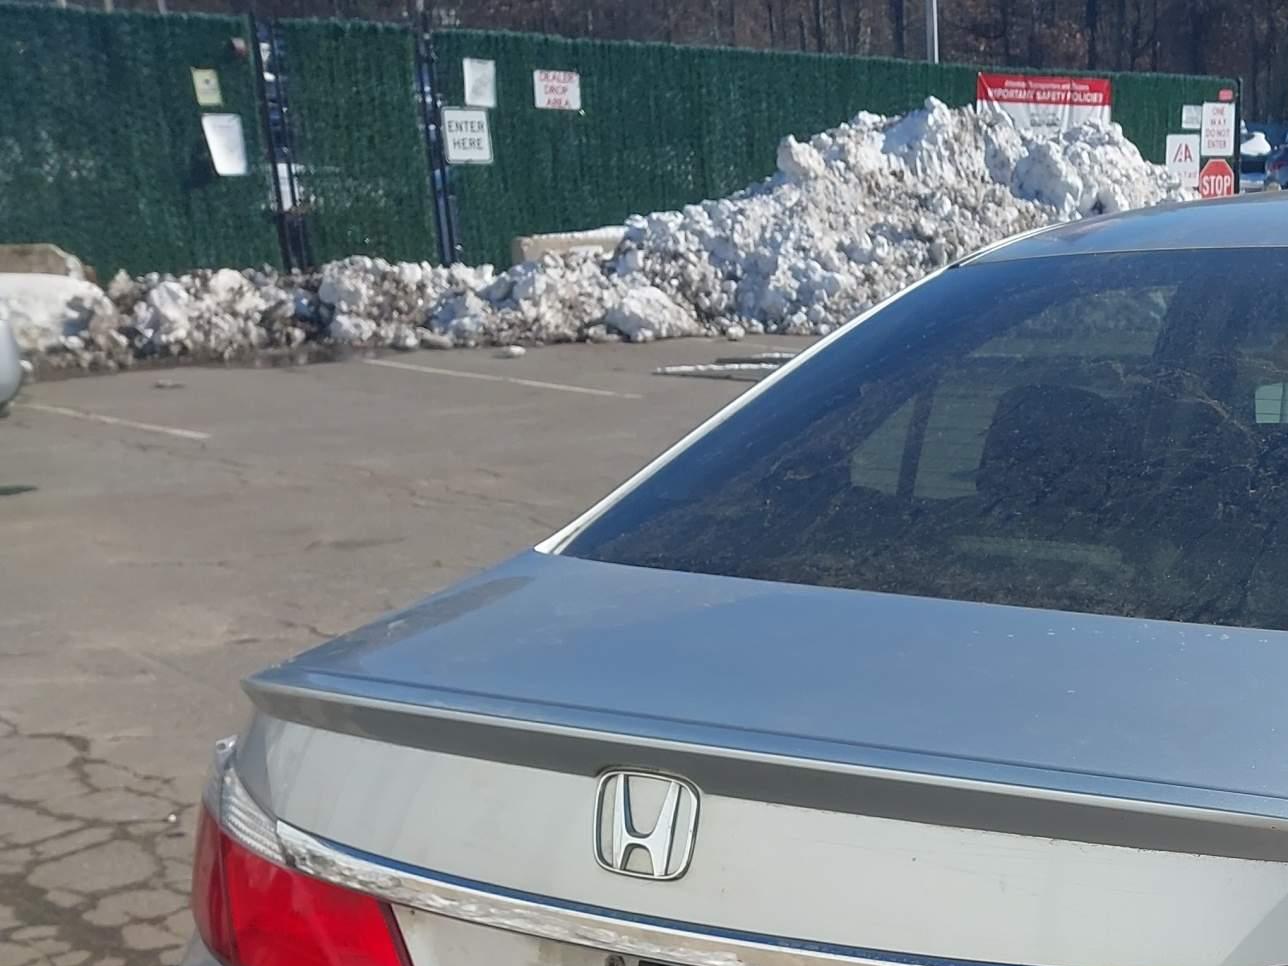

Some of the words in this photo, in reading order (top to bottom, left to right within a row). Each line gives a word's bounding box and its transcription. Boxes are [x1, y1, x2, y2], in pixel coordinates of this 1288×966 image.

[539, 70, 576, 83] DEALER
[544, 84, 568, 95] DROP
[1036, 89, 1066, 101] SAFETY
[448, 119, 485, 134] ENTER
[1205, 129, 1216, 138] DO
[1217, 129, 1230, 138] NOT
[453, 137, 484, 150] HERE
[1202, 175, 1231, 197] STOP
